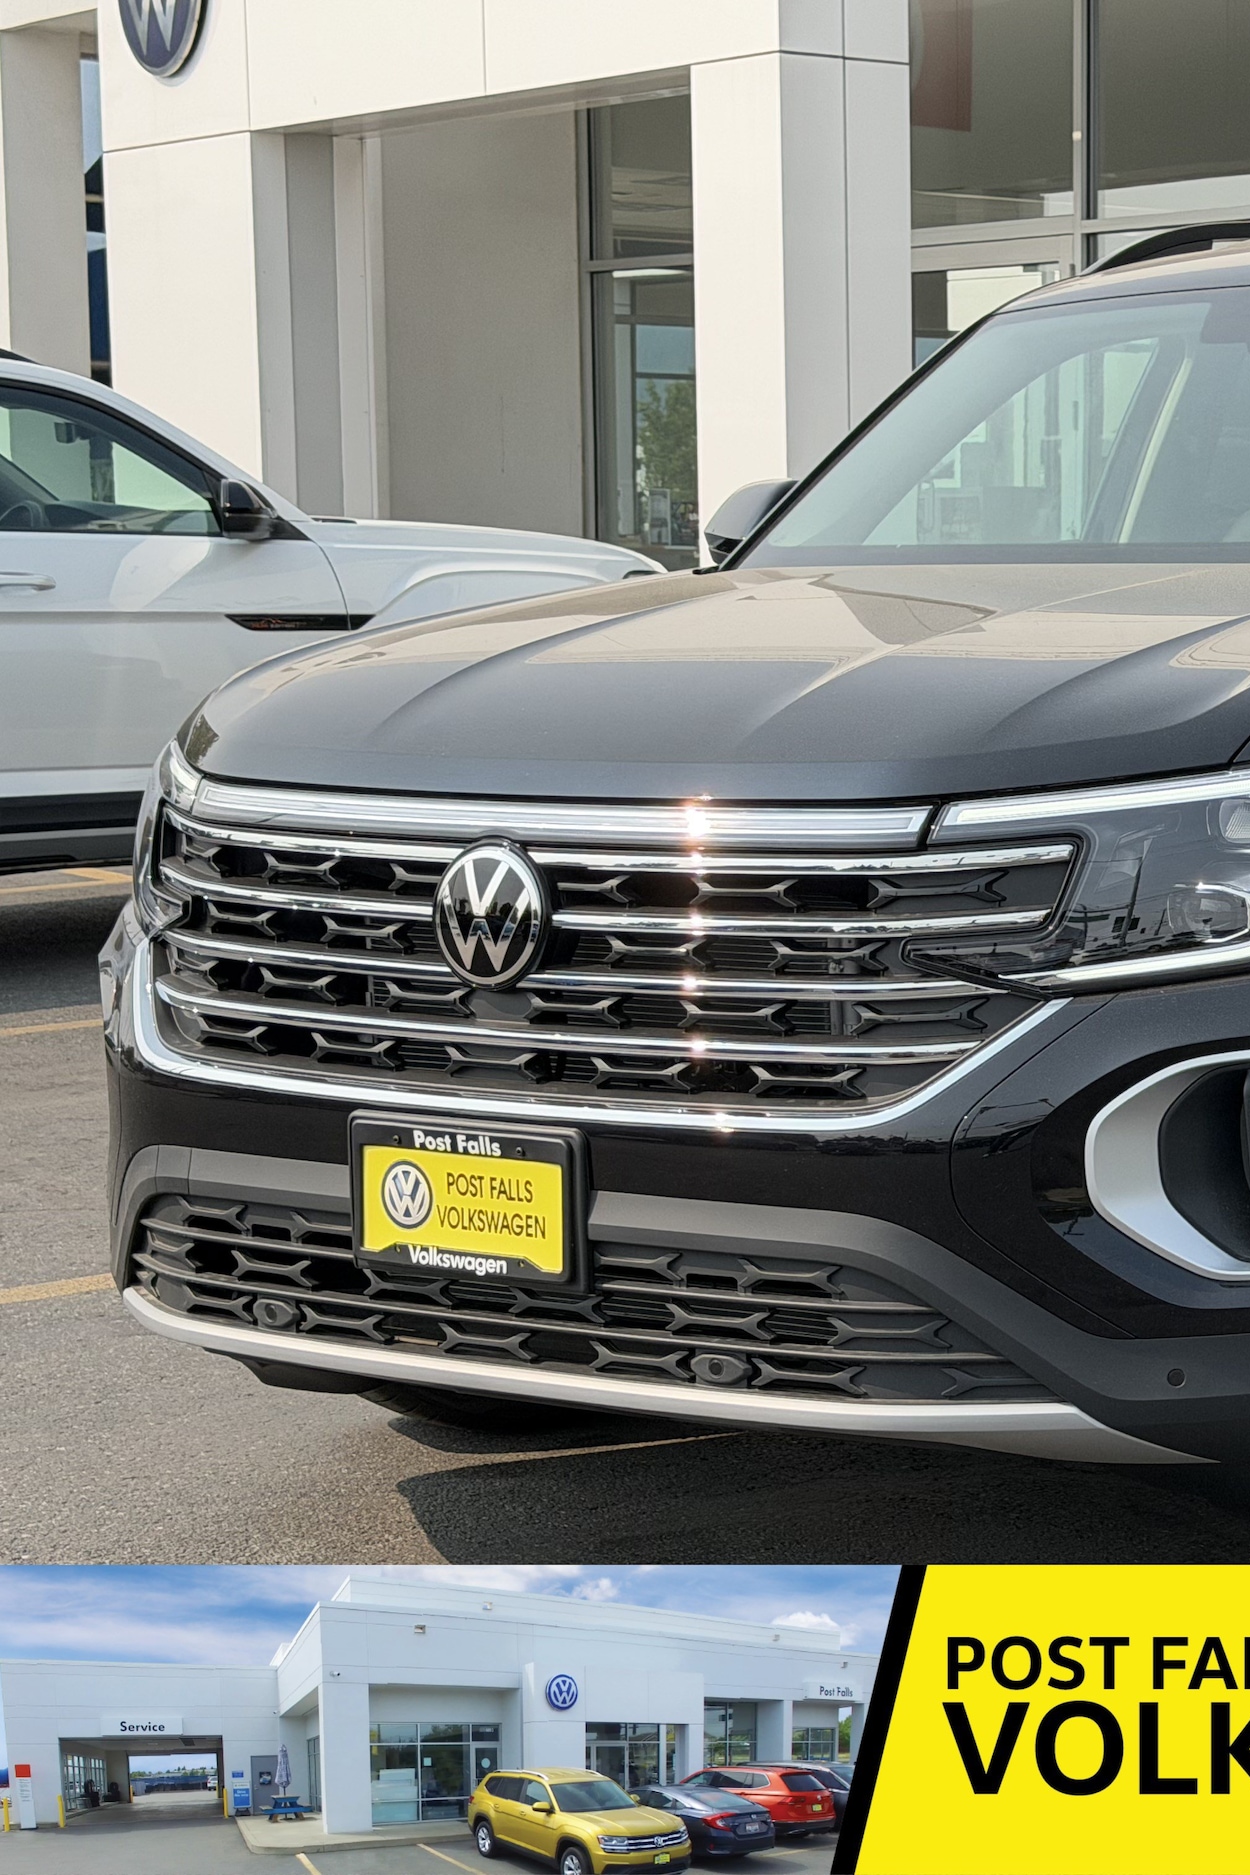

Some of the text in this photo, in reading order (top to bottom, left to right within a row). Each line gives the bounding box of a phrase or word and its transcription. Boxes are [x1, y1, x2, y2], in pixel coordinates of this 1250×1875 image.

[118, 0, 201, 77] W
[413, 1130, 502, 1157] Post Falls
[446, 1172, 533, 1203] POST FALLS
[436, 1204, 546, 1239] VOLKSWAGEN
[407, 1244, 508, 1276] Volkswagen
